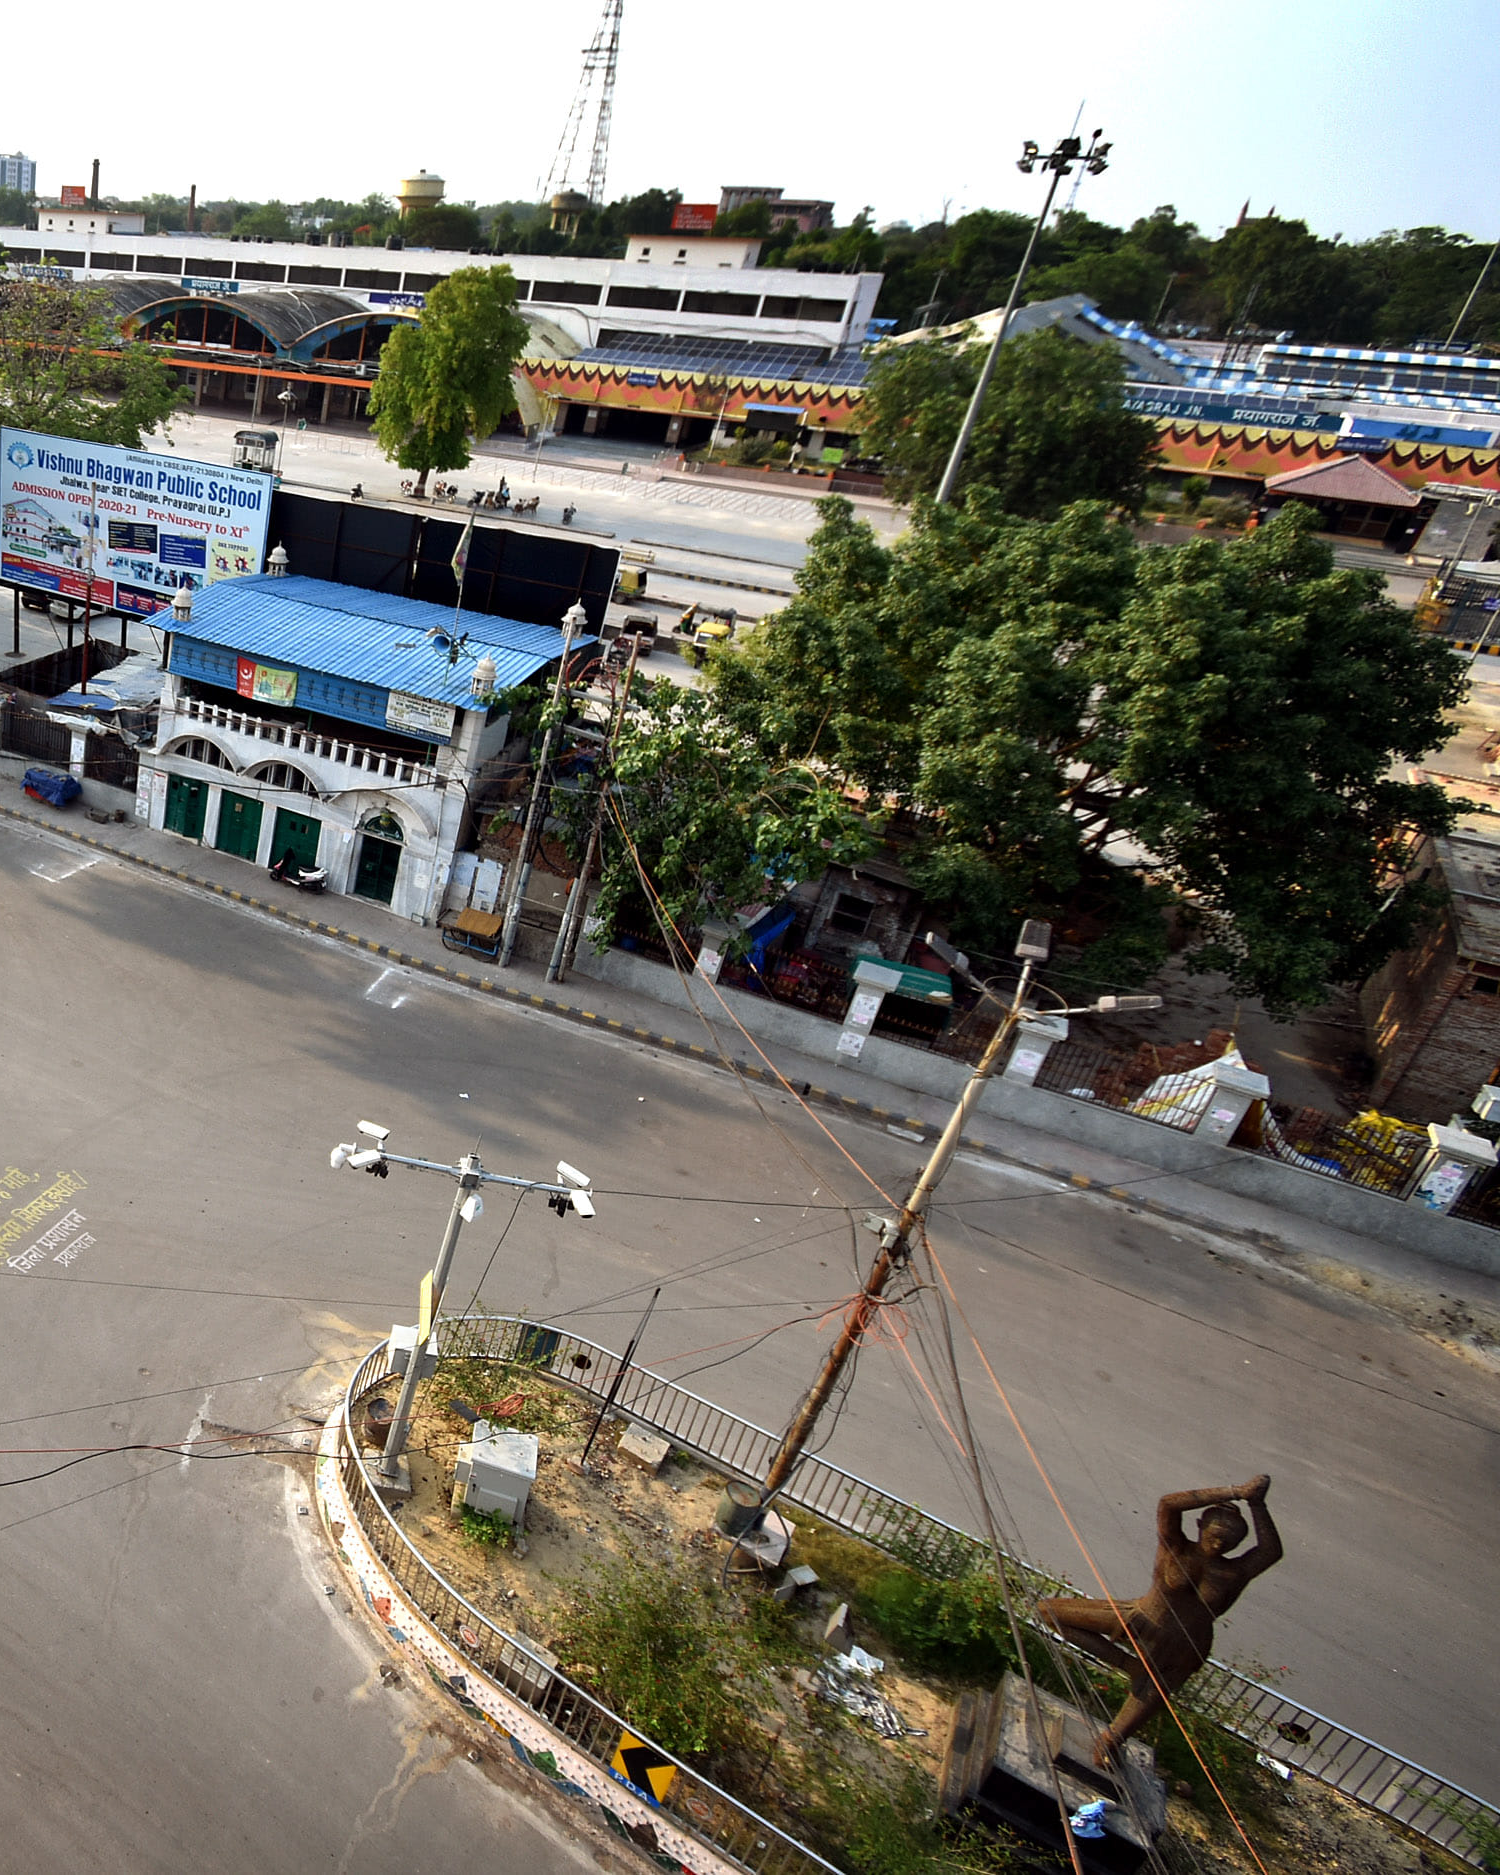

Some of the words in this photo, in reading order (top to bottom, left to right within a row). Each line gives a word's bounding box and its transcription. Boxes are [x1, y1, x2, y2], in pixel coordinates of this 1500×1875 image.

[1231, 408, 1298, 426] प्रयागराज
[36, 448, 83, 476] Vishnu
[86, 458, 153, 489] Bhagwan
[157, 470, 205, 499] Public
[208, 481, 262, 511] School
[92, 483, 110, 494] ear
[111, 486, 128, 498] SIET
[162, 495, 206, 515] Prayagraj
[230, 474, 244, 482] New
[246, 476, 263, 486] Delhi
[11, 480, 66, 501] ADMISSION
[67, 492, 94, 507] OPEN
[97, 498, 137, 516] 2020-21
[147, 508, 212, 534] Pre-Nursery
[215, 524, 227, 535] to
[6, 1244, 48, 1274] जिला
[35, 1207, 87, 1251] प्रशासन
[52, 1230, 98, 1269] प्रयागराज
